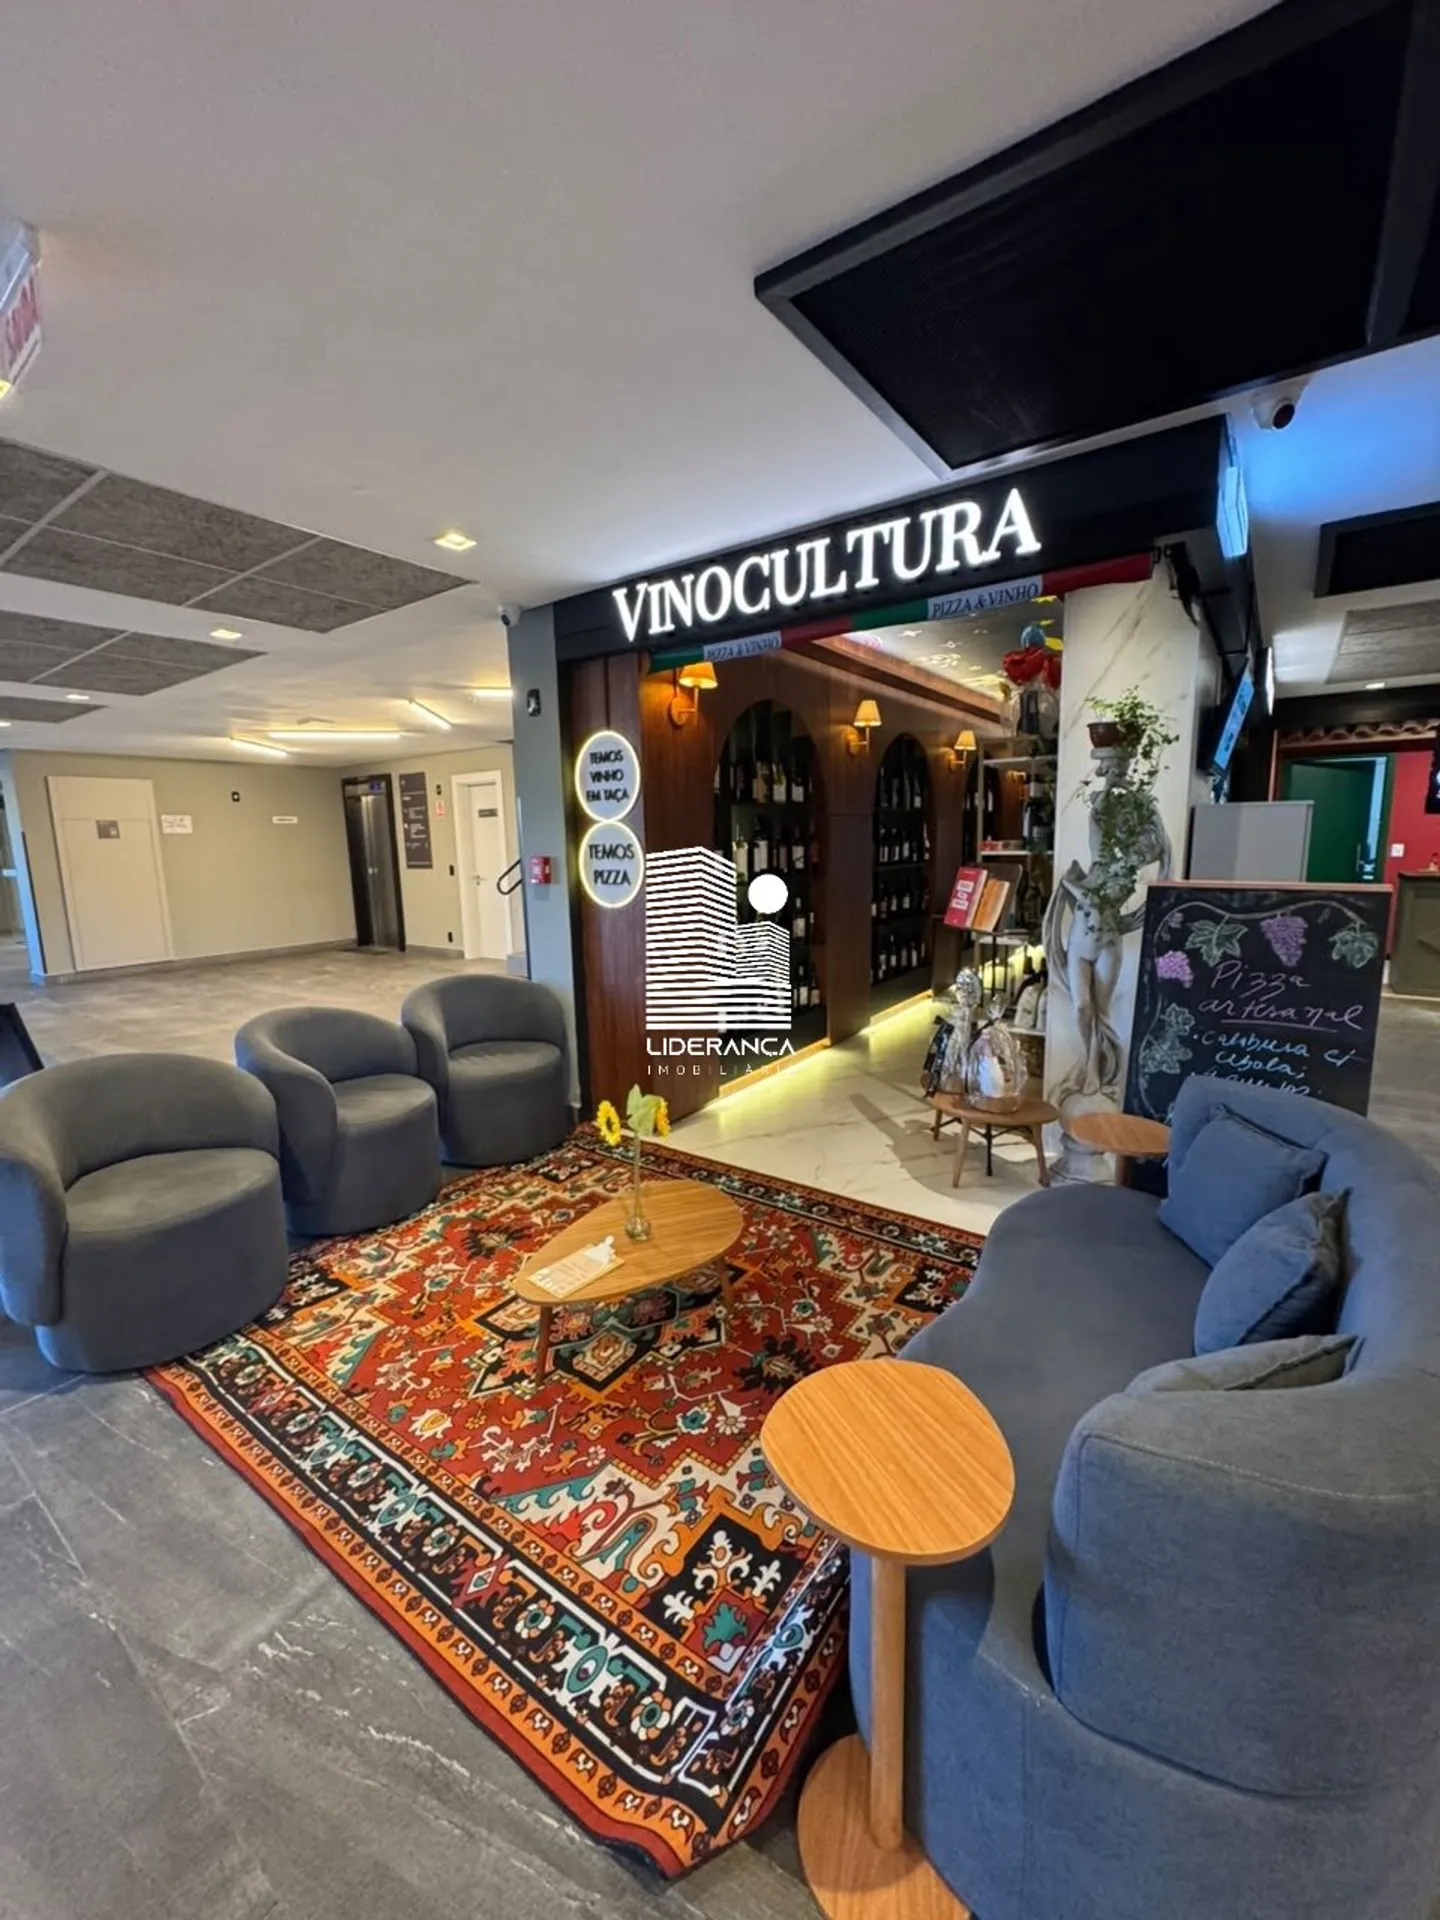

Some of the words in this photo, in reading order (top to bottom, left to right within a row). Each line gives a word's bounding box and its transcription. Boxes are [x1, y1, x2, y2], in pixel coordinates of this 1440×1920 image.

[612, 487, 1042, 642] VINOCULTURA
[932, 598, 972, 618] PIZZA
[975, 593, 985, 609] &
[988, 581, 1039, 606] VINHO
[589, 749, 624, 764] TEMOS
[589, 769, 624, 783] VINHO
[586, 789, 601, 802] EM
[603, 787, 629, 803] TAÇA
[588, 843, 635, 860] TEMOS
[593, 869, 631, 885] PIZZA
[1211, 959, 1311, 1001] Pizza
[1198, 999, 1363, 1030] artesanal
